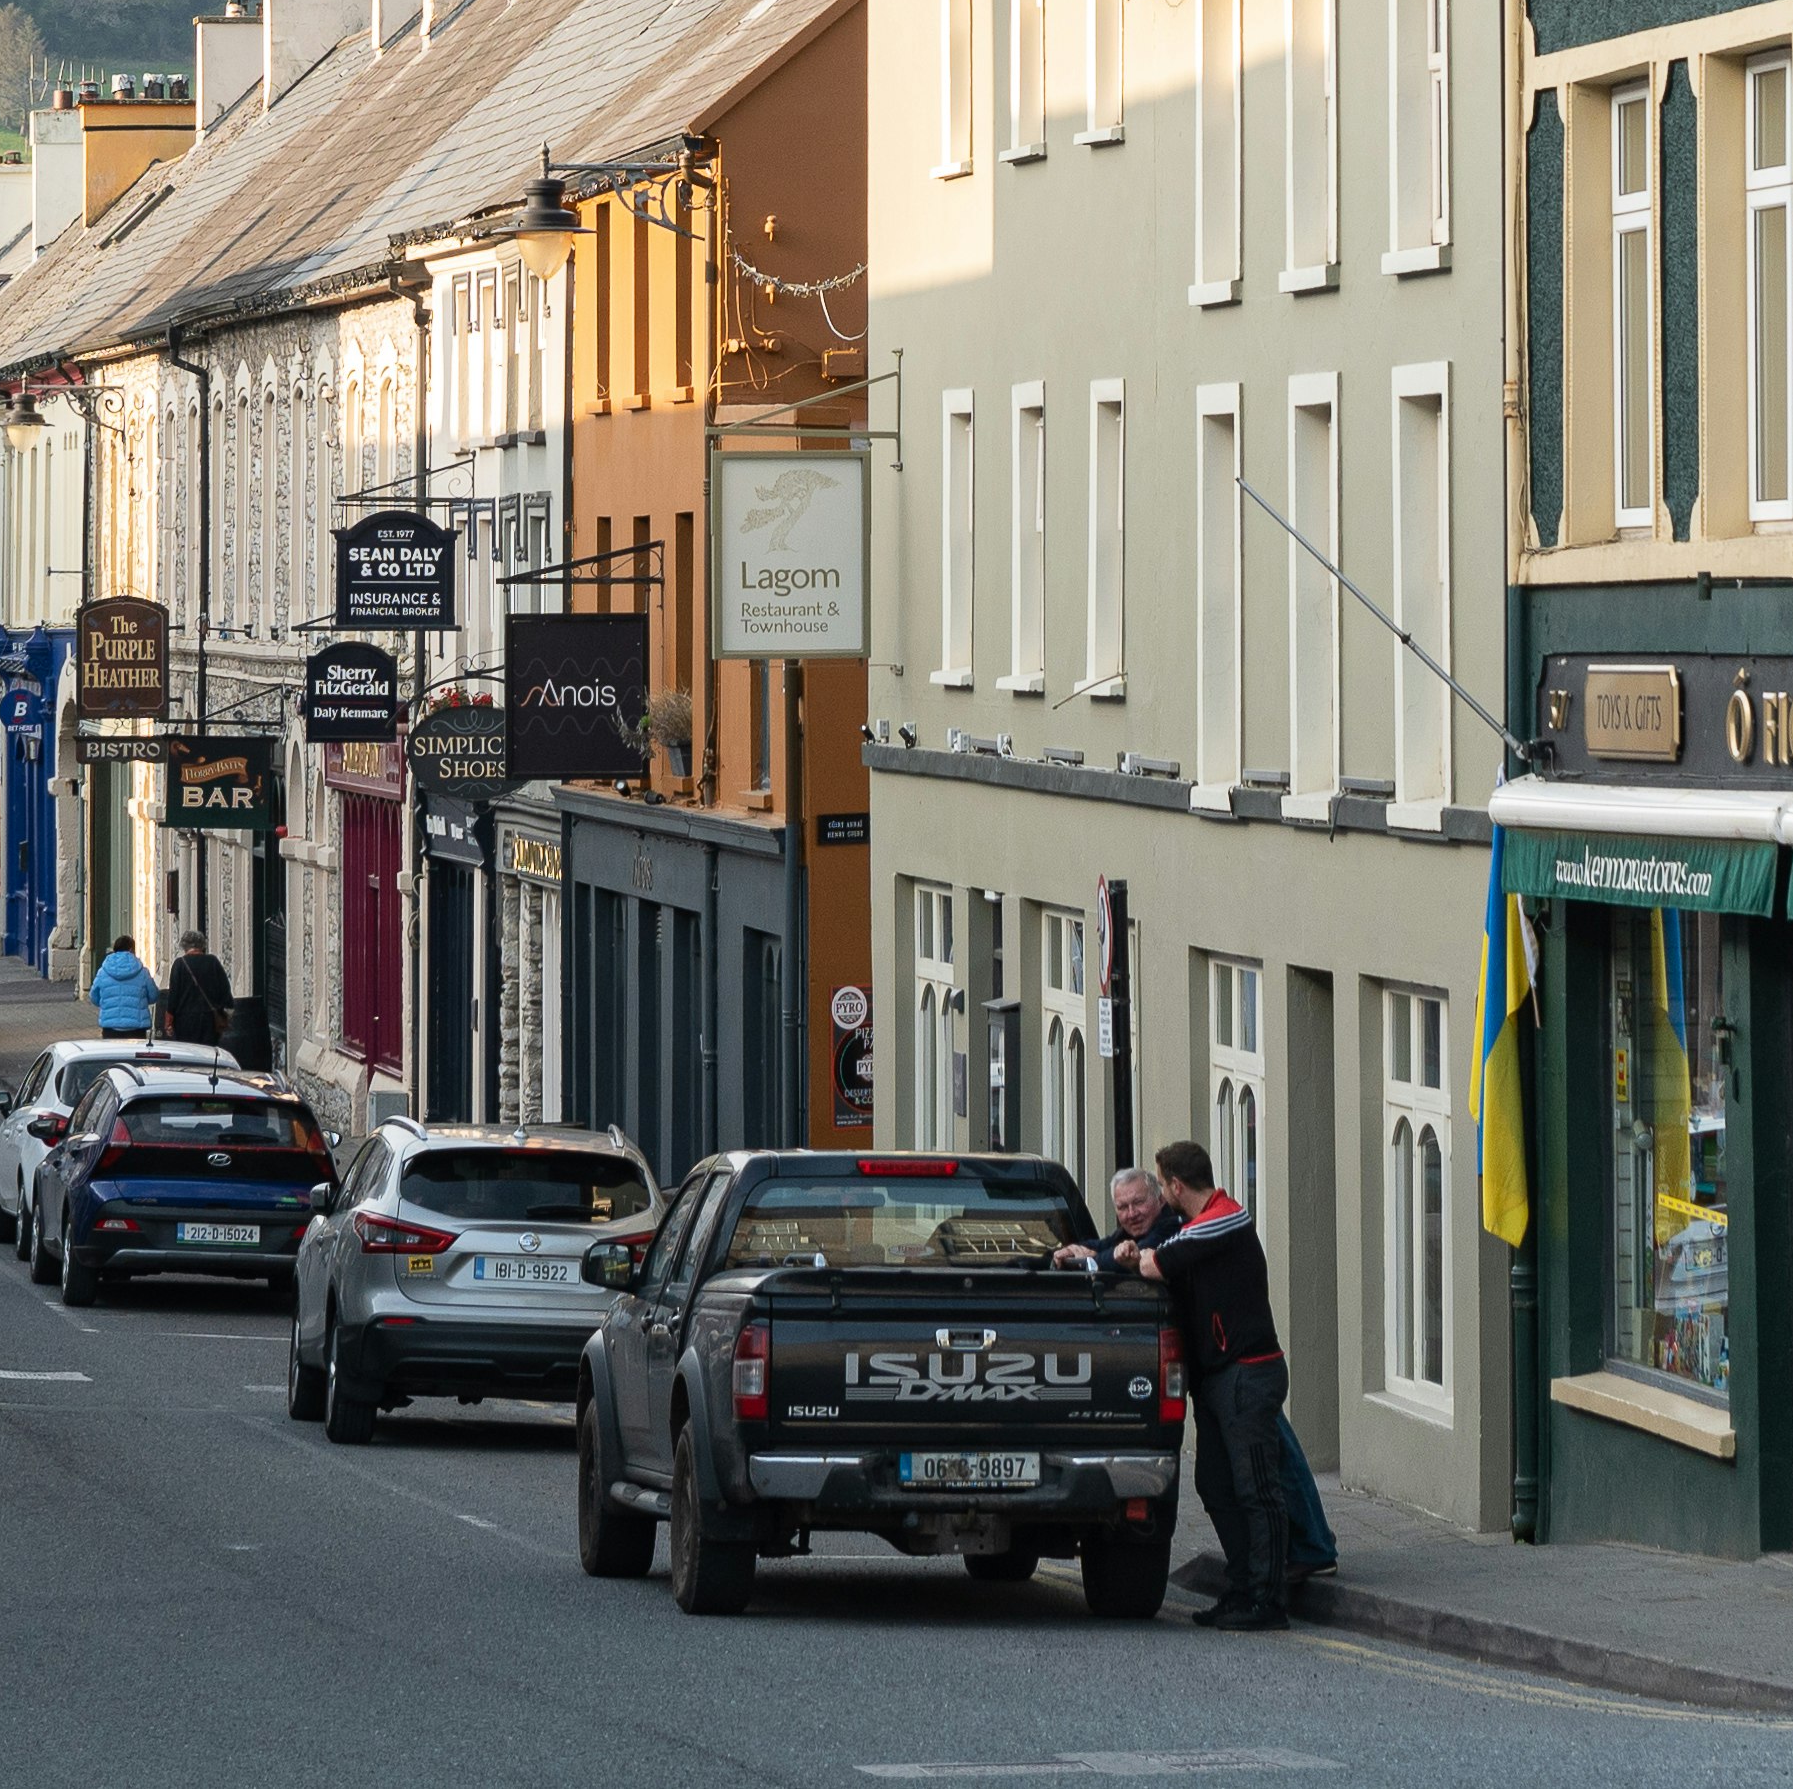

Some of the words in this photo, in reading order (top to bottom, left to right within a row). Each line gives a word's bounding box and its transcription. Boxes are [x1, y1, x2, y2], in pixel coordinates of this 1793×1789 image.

[377, 530, 395, 538] EST.
[396, 530, 415, 538] 1977
[348, 548, 395, 561] SEAN
[400, 548, 443, 561] DALY
[360, 563, 372, 577] &
[378, 563, 400, 577] CO
[405, 563, 436, 577] LTD
[741, 561, 840, 597] Lagom
[350, 593, 428, 605] INSURANCE
[432, 593, 441, 605] &
[350, 608, 399, 616] FINANCIAL
[402, 608, 440, 616] BROKER
[741, 602, 822, 617] Restaurant
[827, 601, 840, 617] &
[111, 615, 138, 634] The
[741, 619, 828, 634] Townhouse
[90, 631, 156, 661] PURPLE
[83, 662, 161, 688] HEATHER
[327, 665, 376, 683] Sherry
[315, 680, 389, 696] FitzGerald
[538, 678, 616, 707] Anois
[313, 707, 338, 720] Daly
[340, 707, 388, 718] Kenmare
[1596, 694, 1621, 729] TOYS
[1623, 696, 1632, 725] &
[1635, 694, 1663, 731] GIFTS
[1726, 667, 1755, 764] Ó
[86, 742, 161, 758] BISTRO
[414, 736, 505, 756] SIMPLIC
[183, 786, 254, 809] BAR
[836, 1002, 864, 1014] PYRO
[190, 1227, 254, 1241] 212-D-15024
[494, 1262, 567, 1281] 181-D-9922
[845, 1353, 1092, 1385] ISUZU
[788, 1406, 839, 1417] ISUZU
